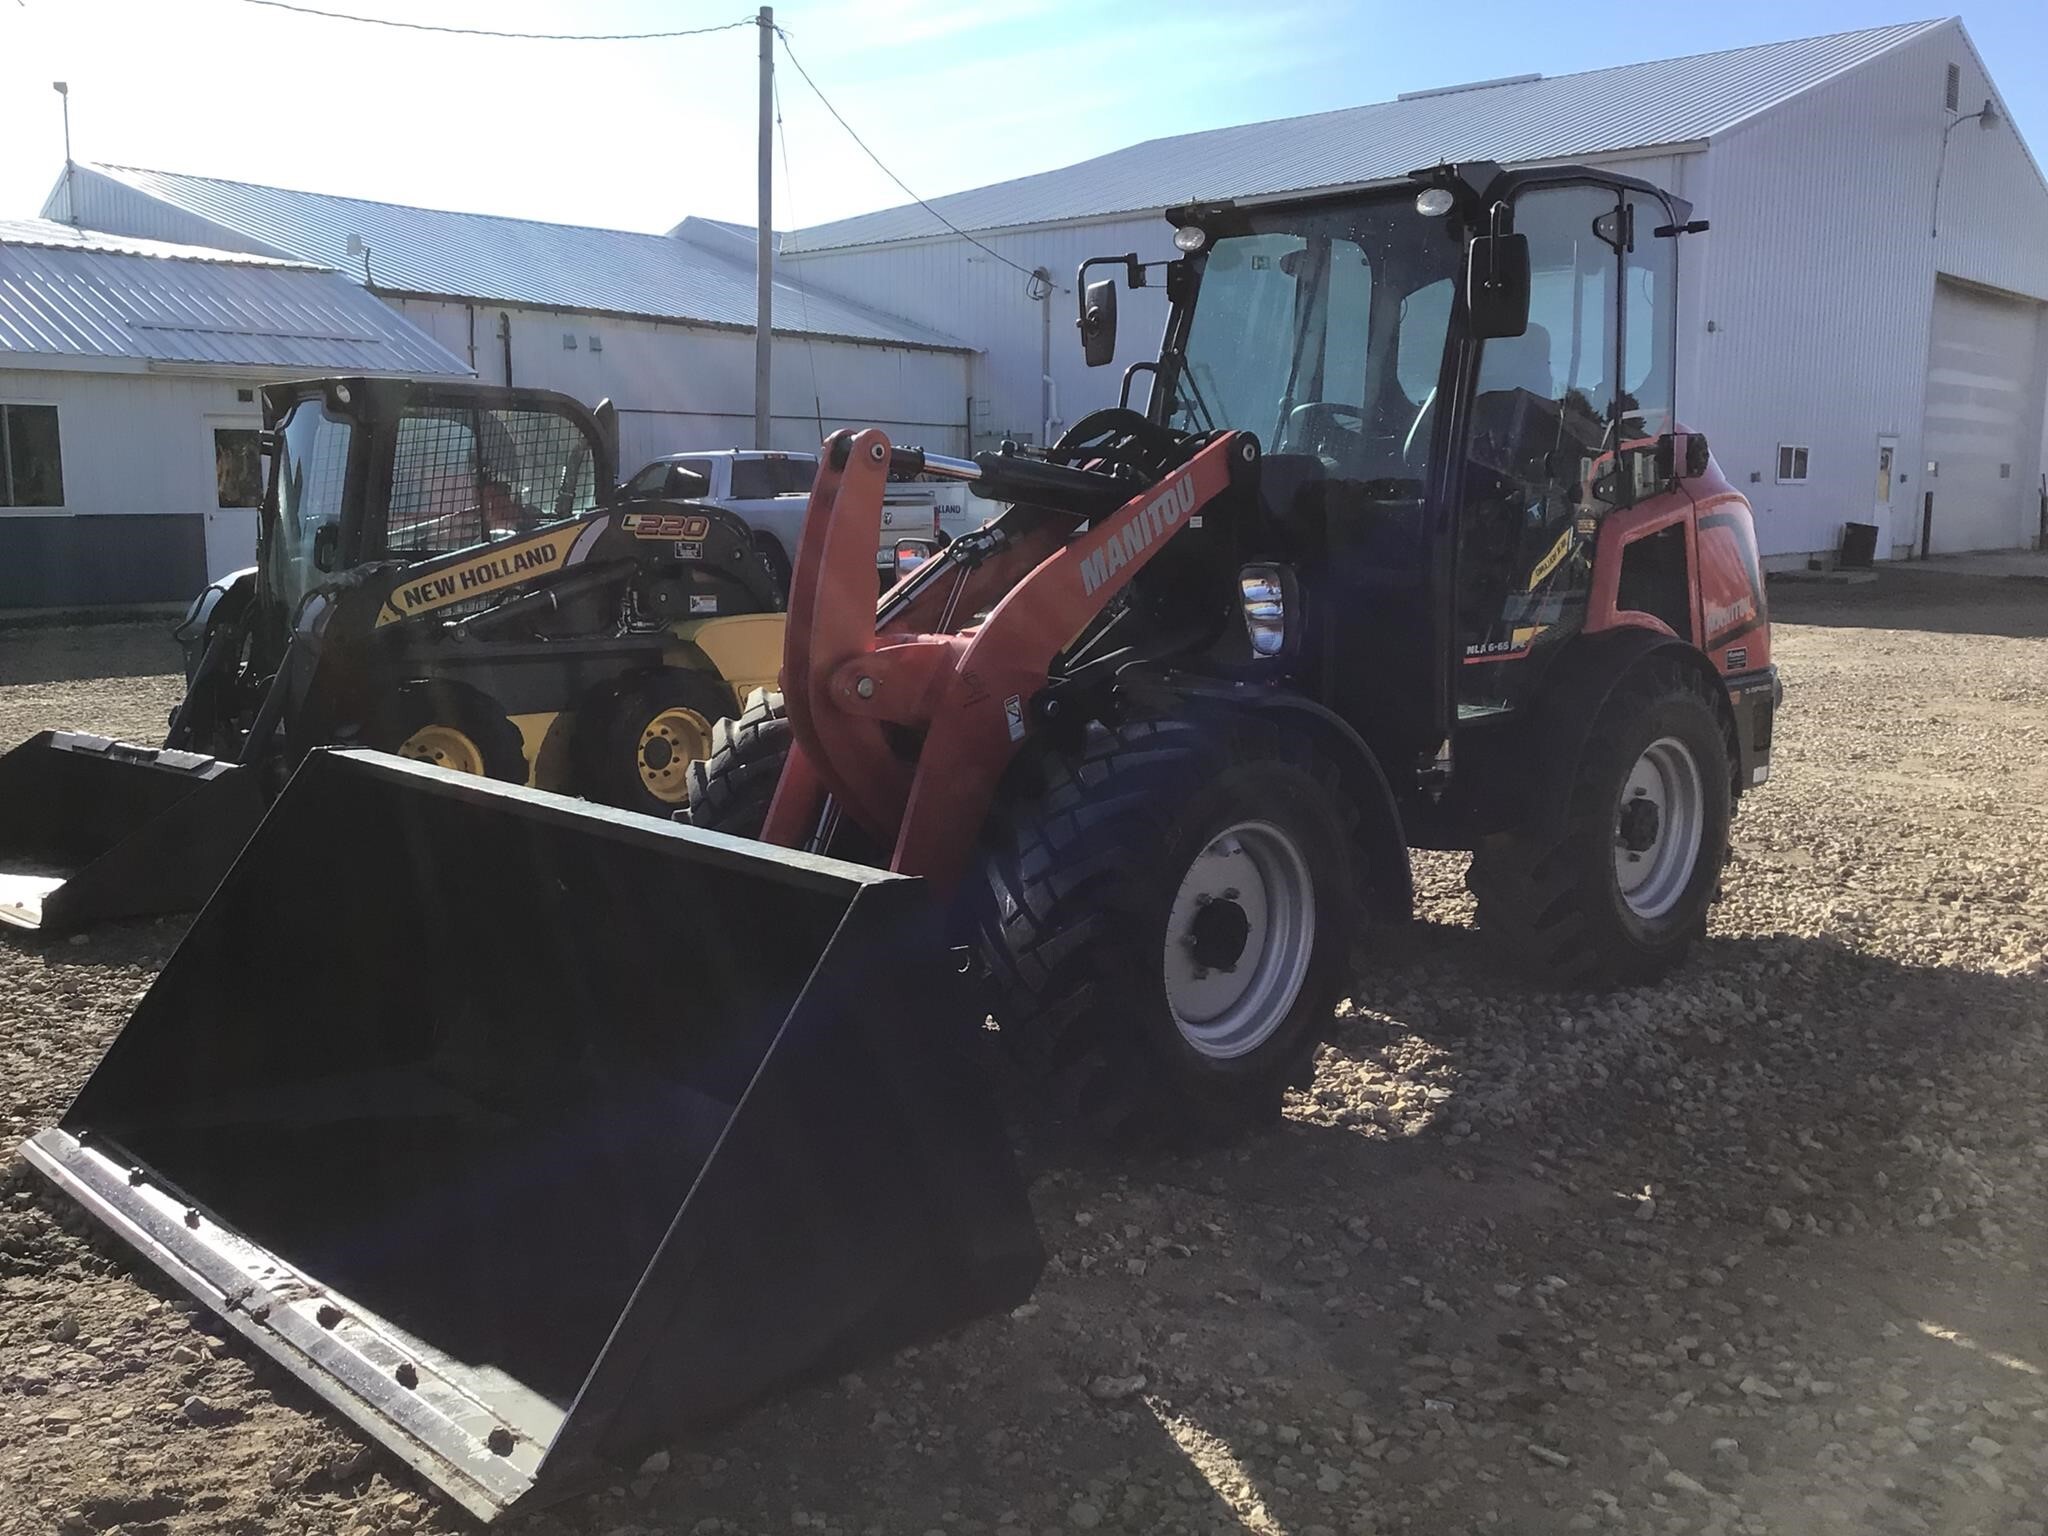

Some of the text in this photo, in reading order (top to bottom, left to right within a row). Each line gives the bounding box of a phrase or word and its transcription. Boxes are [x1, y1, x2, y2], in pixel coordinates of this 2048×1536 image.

[403, 543, 557, 608] NEW HOLLAND
[1080, 473, 1195, 596] MANITOU
